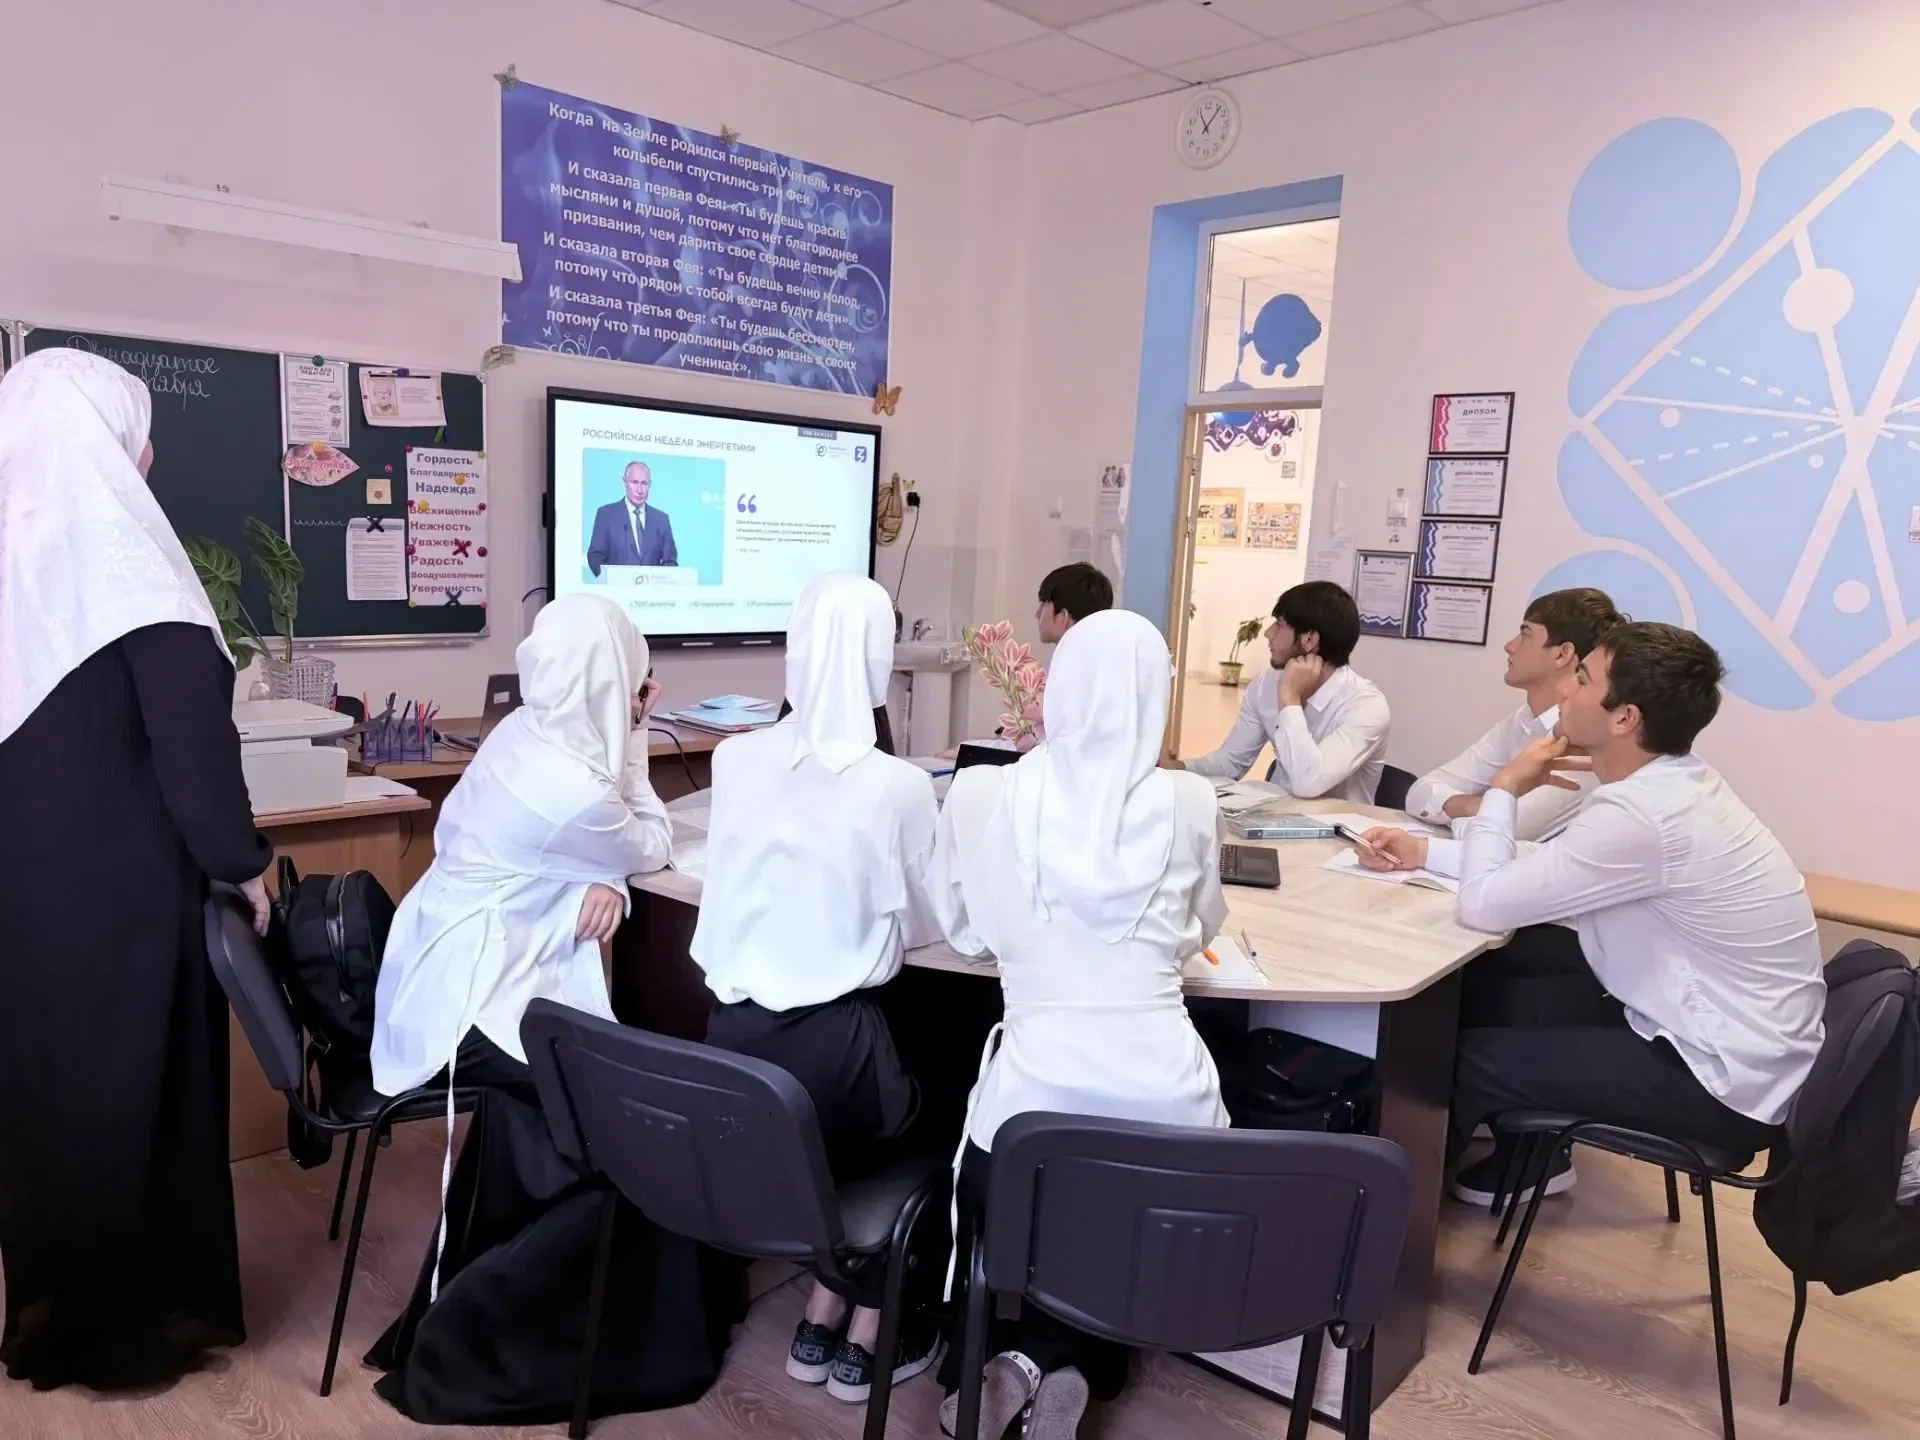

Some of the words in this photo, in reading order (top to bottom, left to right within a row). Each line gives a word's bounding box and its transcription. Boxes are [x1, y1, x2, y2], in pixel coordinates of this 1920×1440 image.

[549, 102, 594, 127] Когда
[602, 119, 619, 133] на
[623, 122, 668, 146] Земле
[671, 137, 726, 162] родился
[729, 154, 777, 175] первый
[780, 165, 831, 192] Учитель,
[834, 183, 841, 193] к
[843, 185, 861, 199] его
[613, 145, 683, 173] колыбели
[687, 164, 759, 192] спустились
[762, 184, 782, 200] три
[568, 160, 579, 176] И
[583, 167, 641, 190] сказала
[644, 181, 693, 203] первая
[696, 193, 726, 210] Фея:
[731, 202, 756, 218] «Ты
[759, 207, 805, 230] будешь
[807, 221, 848, 240] красив
[550, 182, 618, 207] мыслями
[623, 198, 631, 211] и
[635, 200, 685, 225] душой,
[688, 214, 735, 237] потому
[738, 226, 759, 240] что
[762, 231, 783, 245] нет
[785, 235, 859, 263] благороднее
[563, 209, 645, 239] призвания,
[649, 227, 675, 242] чем
[678, 234, 725, 253] дарить
[727, 245, 756, 260] свое
[759, 251, 801, 270] сердце
[543, 231, 555, 246] И
[559, 237, 617, 258] сказала
[621, 249, 669, 269] вторая
[672, 258, 704, 276] Фея:
[708, 266, 734, 282] «Ты
[737, 271, 784, 291] будешь
[786, 284, 820, 299] вечно
[555, 259, 608, 282] потому
[612, 269, 636, 285] что
[640, 275, 682, 294] рядом
[686, 284, 694, 296] с
[696, 285, 734, 303] тобой
[737, 295, 778, 312] всегда
[781, 301, 813, 320] будут
[549, 285, 560, 300] И
[564, 290, 622, 310] сказала
[626, 300, 672, 319] третья
[675, 308, 707, 324] Фея:
[710, 314, 737, 330] «Ты
[739, 319, 786, 339] будешь
[788, 327, 855, 354] бессмертен,
[546, 309, 600, 331] потому
[604, 318, 628, 333] что
[631, 323, 650, 337] ты
[654, 327, 740, 351] продолжишь
[742, 341, 774, 357] свою
[776, 348, 814, 364] жизнь
[825, 357, 857, 371] своих
[679, 353, 751, 373] учениках».
[1462, 408, 1497, 416] ДИПЛОМ
[416, 453, 473, 466] Гордость
[582, 428, 652, 443] РОССИЙСКАЯ
[654, 435, 694, 447] НЕДЕЛЯ
[696, 439, 756, 454] ЭНЕРГЕТИКИ
[415, 482, 476, 495] Надежда
[410, 521, 471, 532] Нежность
[411, 556, 464, 566] Радость
[411, 571, 485, 580] Воодушевление
[411, 584, 483, 594] Уверенность
